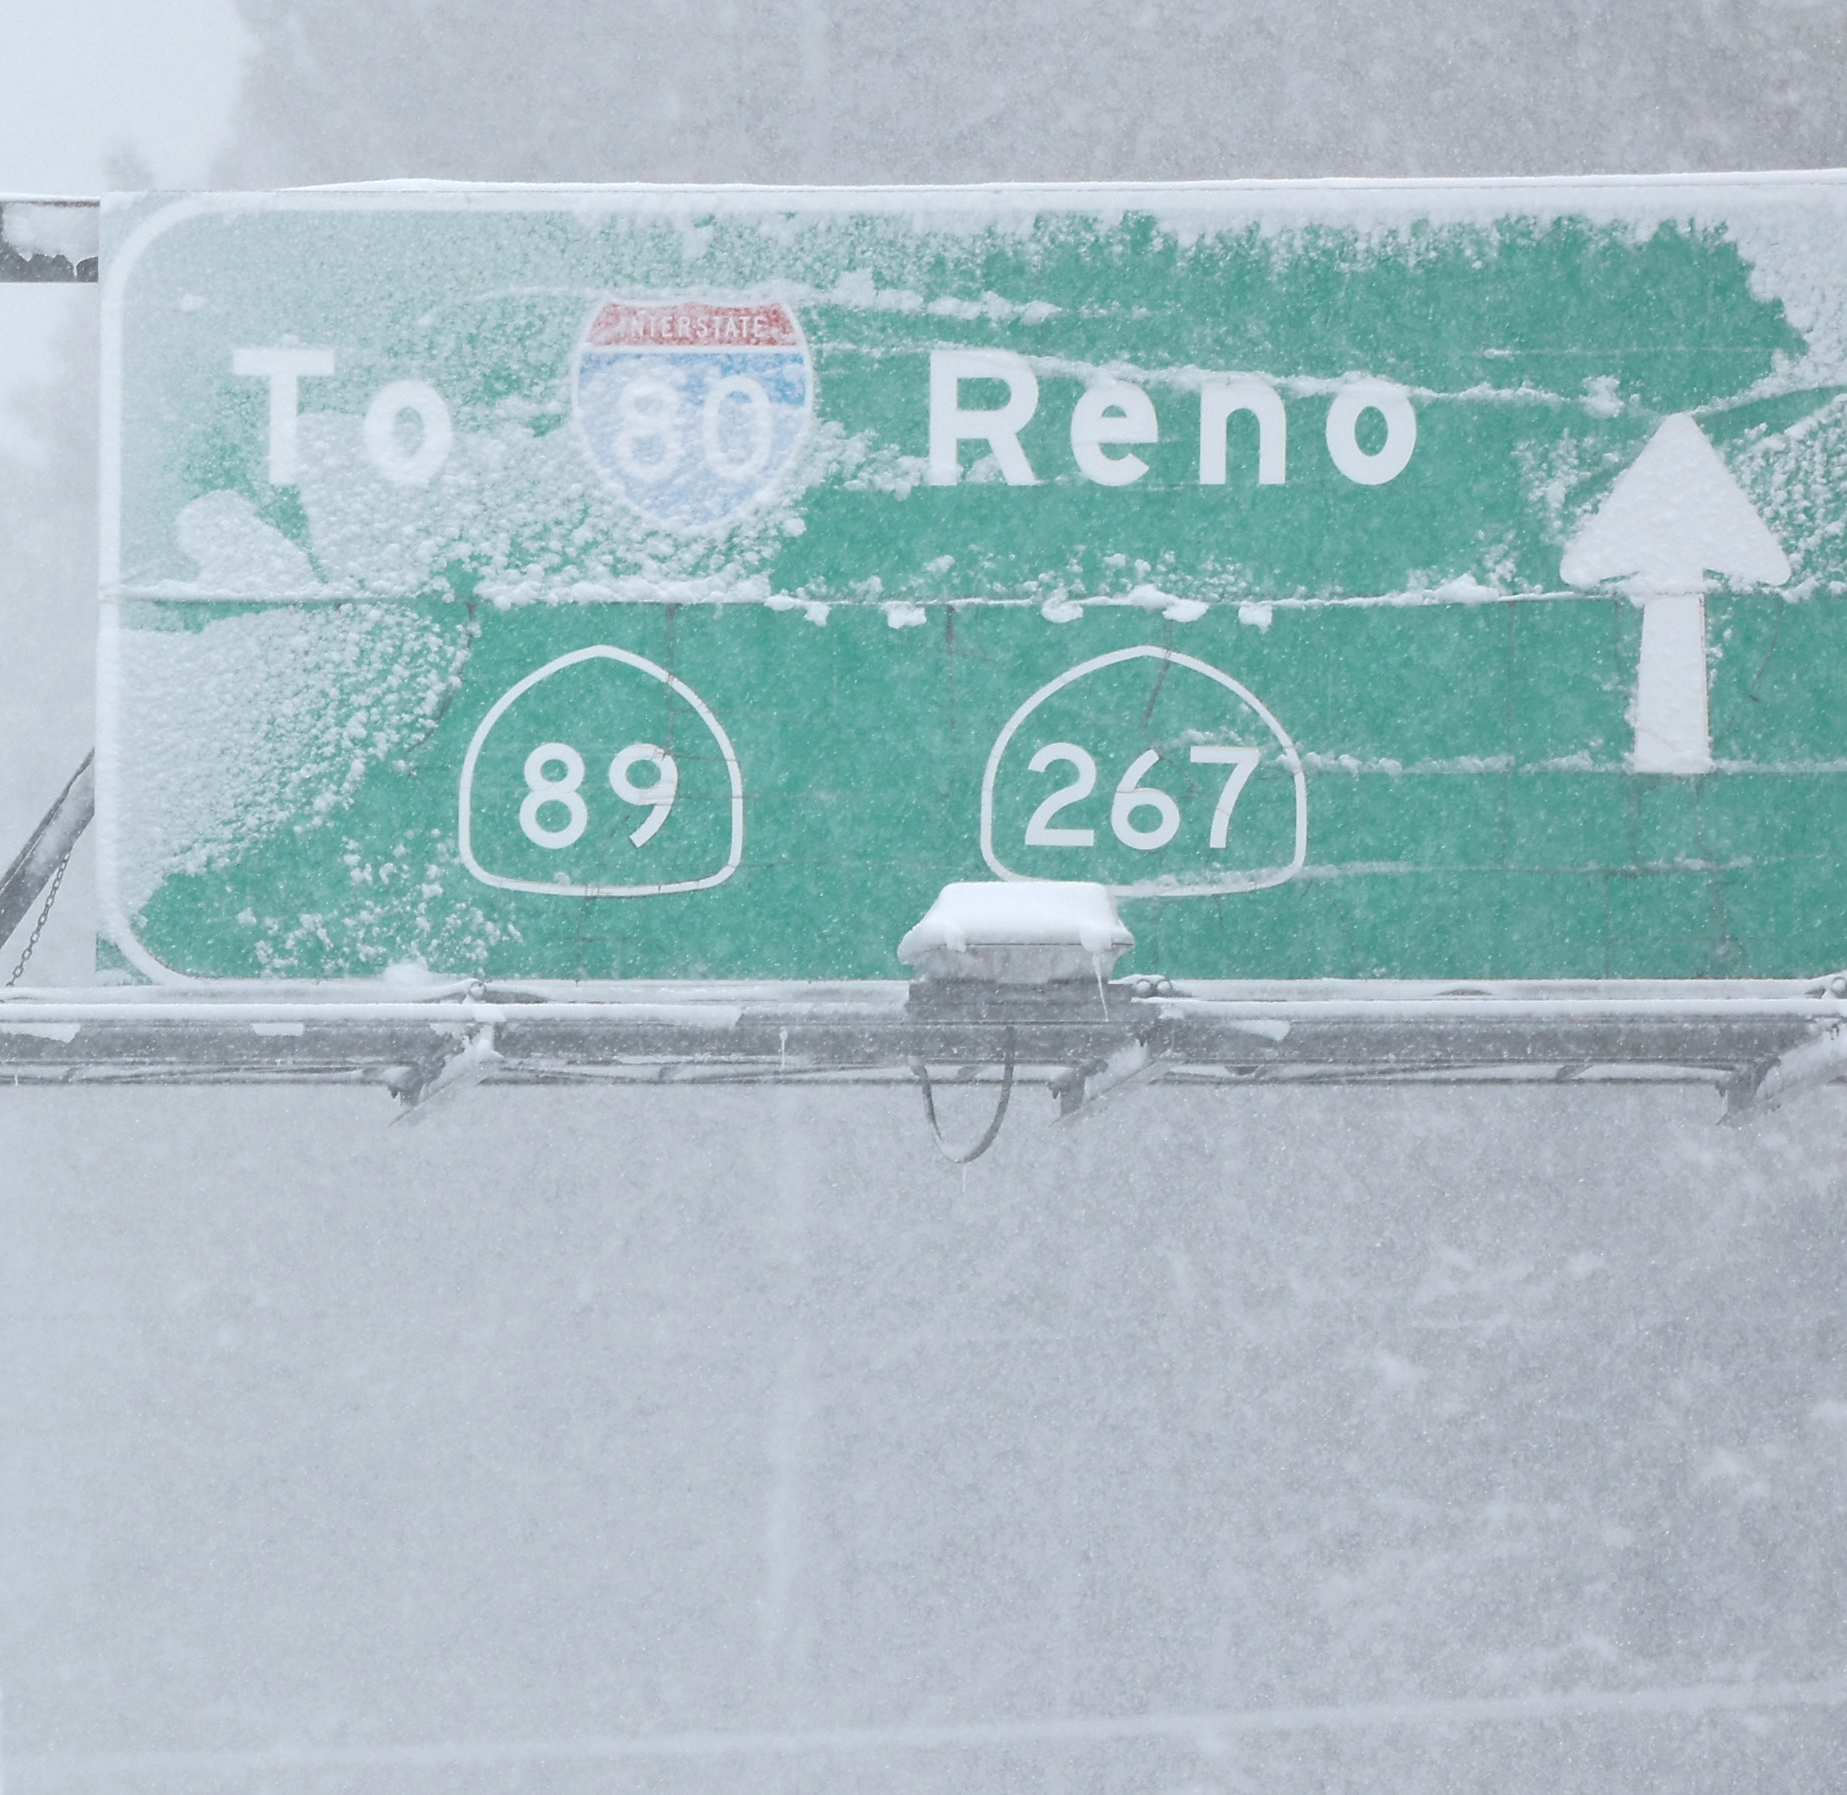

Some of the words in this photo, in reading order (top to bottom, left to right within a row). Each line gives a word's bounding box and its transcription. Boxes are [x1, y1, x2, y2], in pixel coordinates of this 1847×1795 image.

[232, 346, 455, 486] To
[615, 374, 773, 481] 80
[928, 348, 1420, 486] Reno
[519, 743, 679, 850] 89
[1024, 742, 1263, 850] 267
